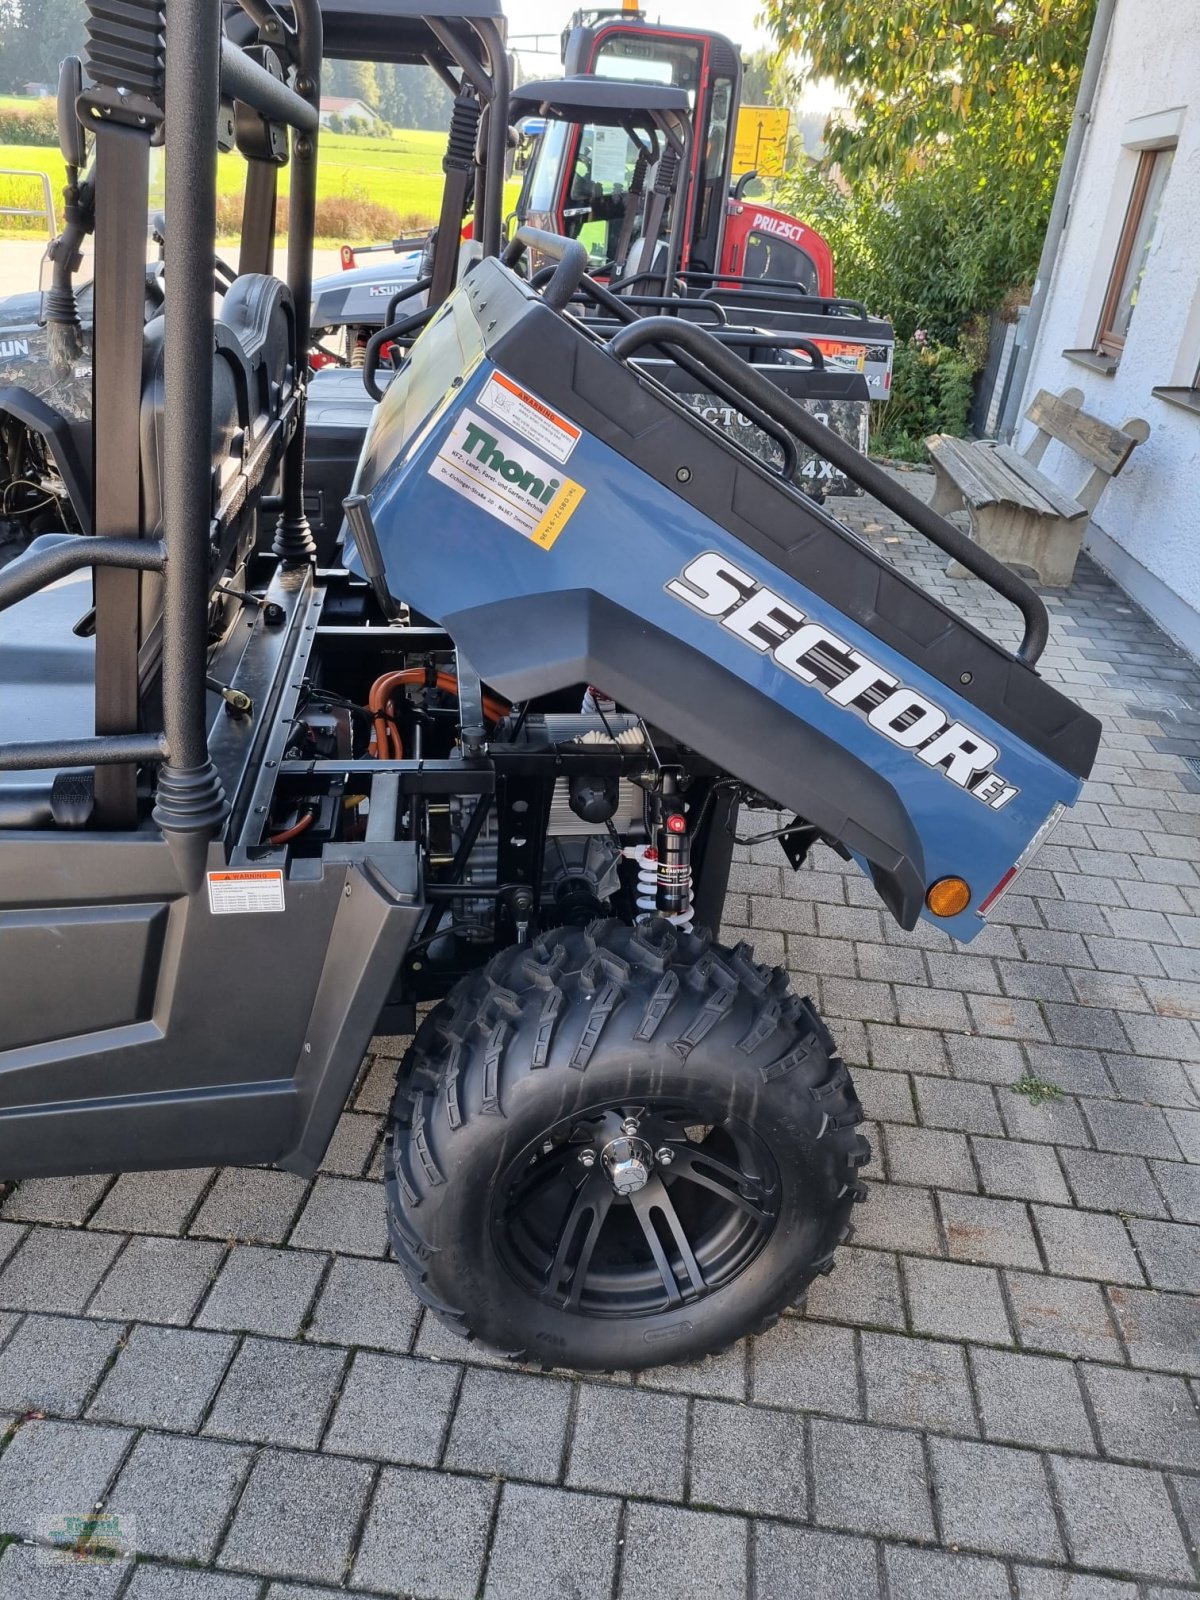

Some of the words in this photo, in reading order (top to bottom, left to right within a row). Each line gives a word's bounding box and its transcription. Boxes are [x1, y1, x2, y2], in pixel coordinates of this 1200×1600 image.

[0, 339, 29, 357] UN
[522, 394, 555, 421] WARNING
[461, 421, 560, 506] Thoni
[481, 470, 497, 483] Forst-
[496, 480, 507, 490] und
[507, 487, 544, 514] Garten-Technik
[665, 551, 999, 789] SECTOR
[971, 773, 1019, 810] E1
[233, 872, 267, 880] WARNING
